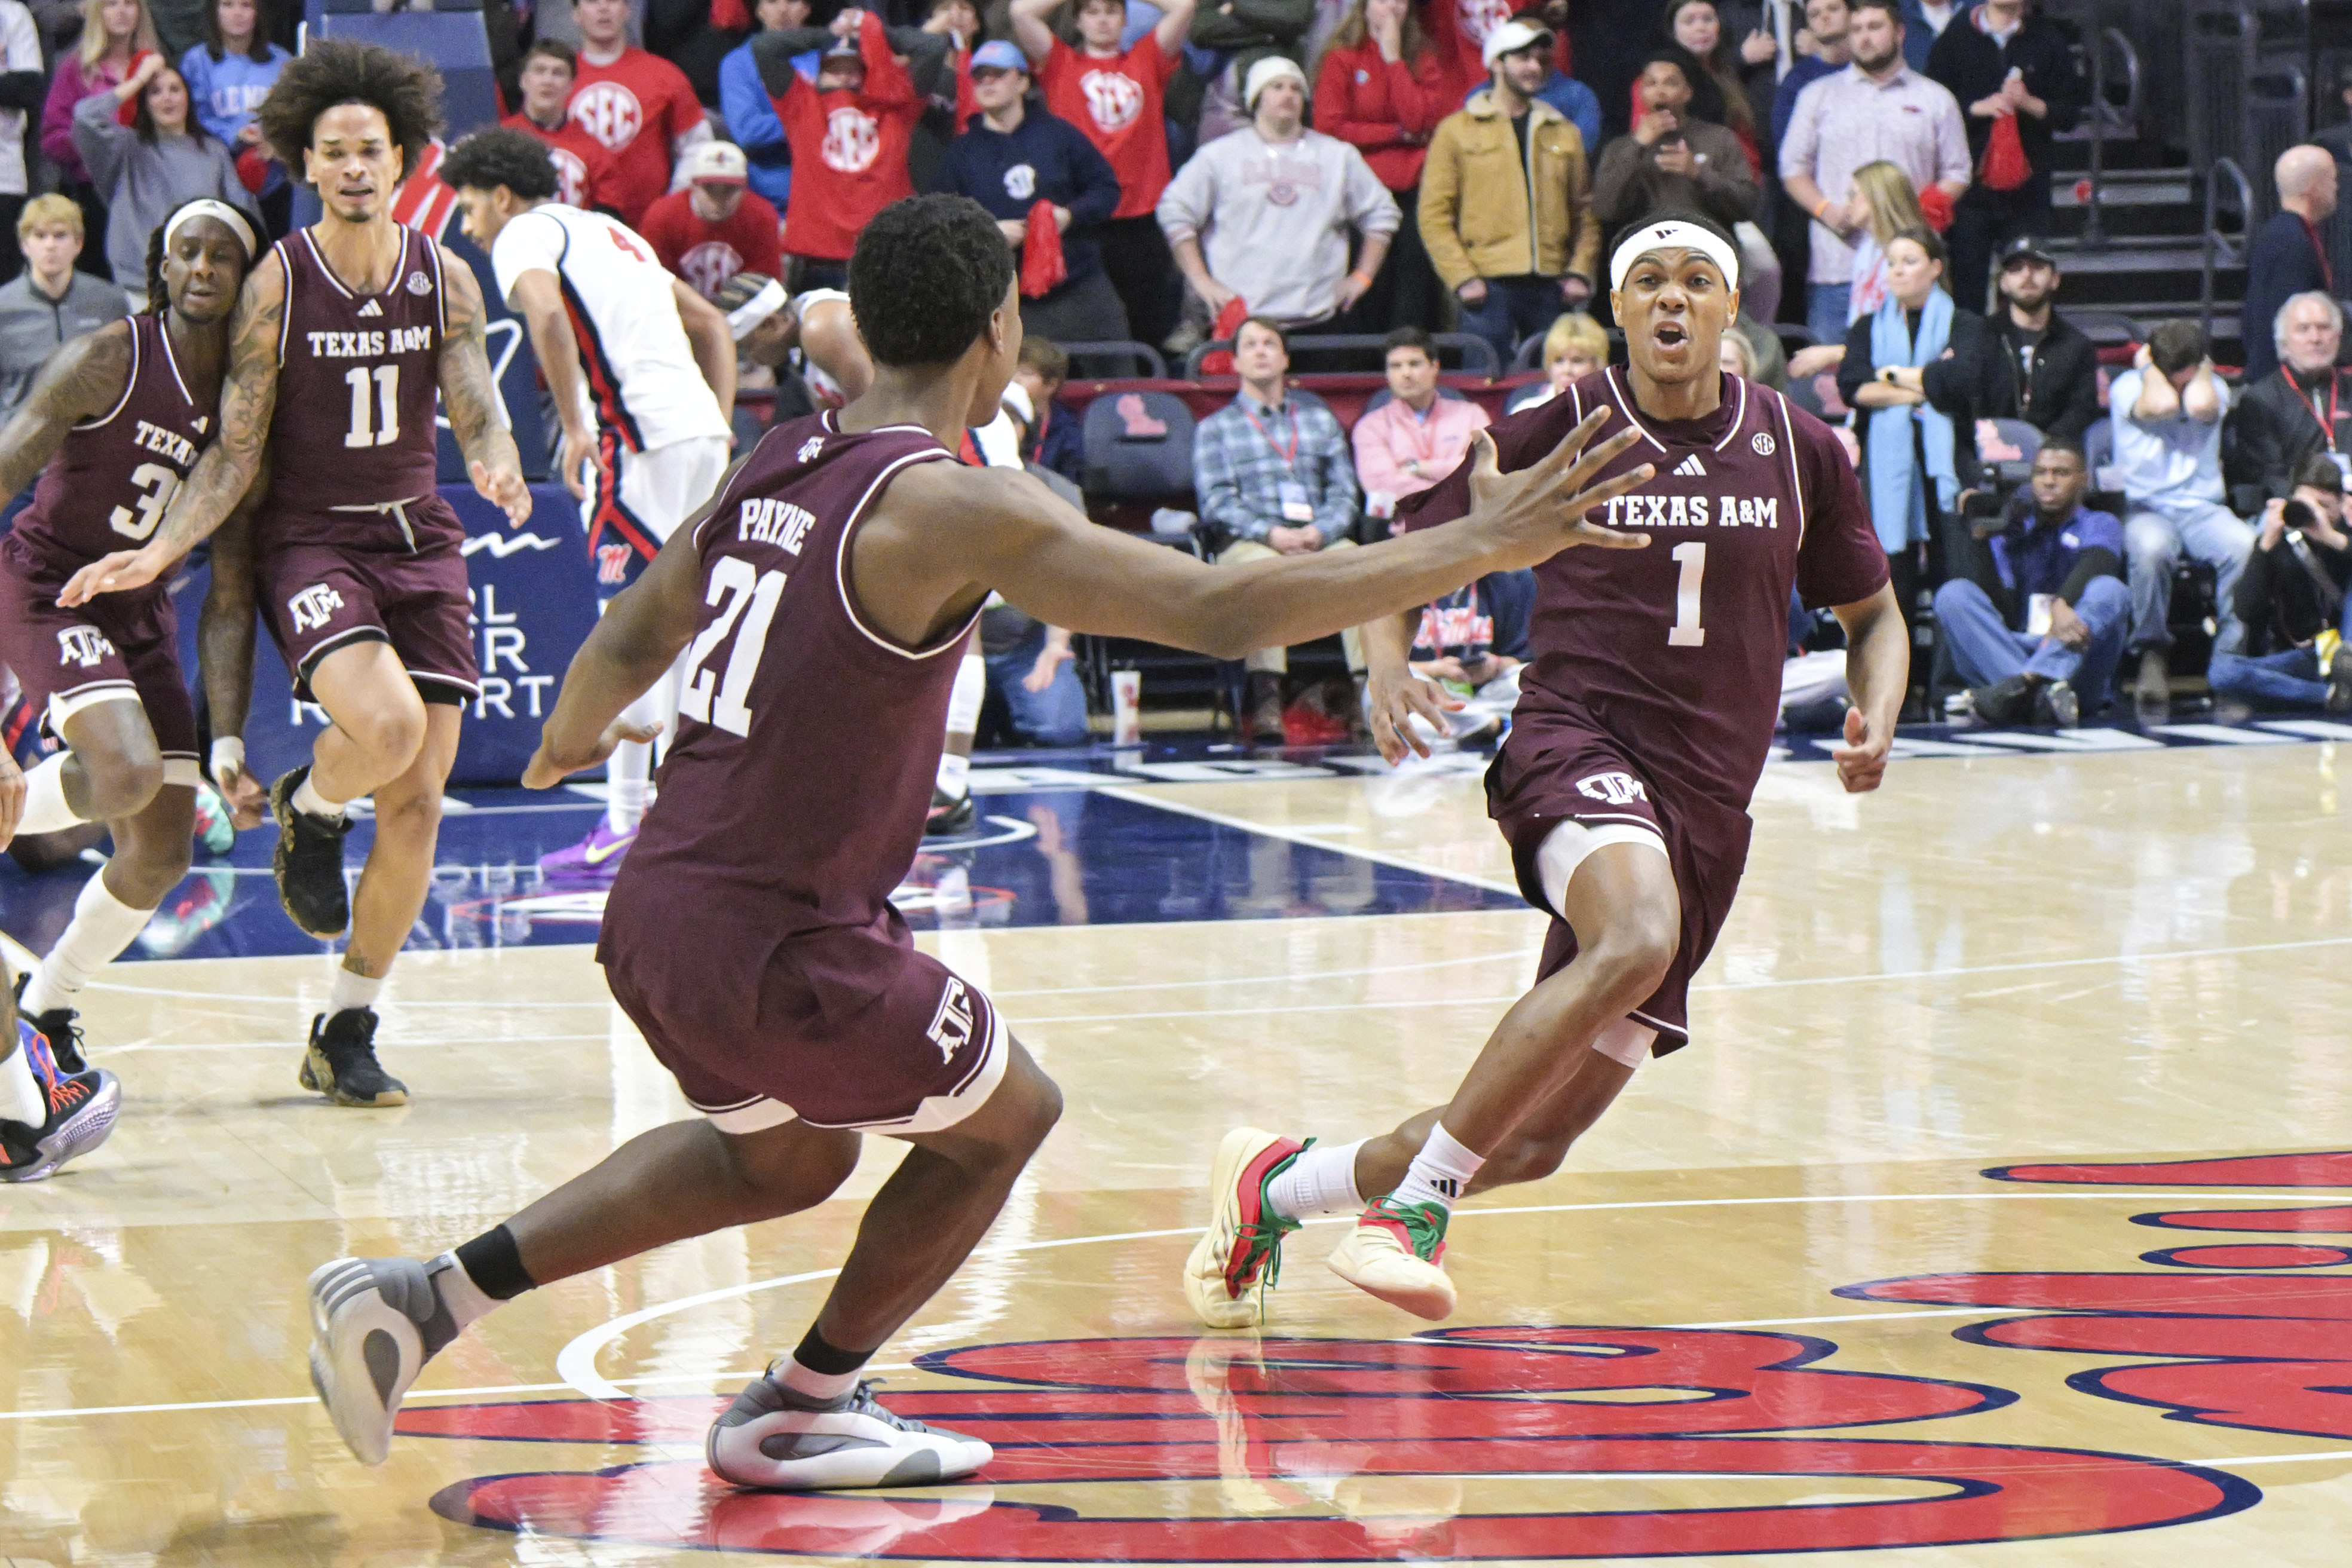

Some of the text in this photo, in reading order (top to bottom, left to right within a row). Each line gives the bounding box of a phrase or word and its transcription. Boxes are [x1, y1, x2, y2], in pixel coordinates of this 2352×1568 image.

[573, 87, 636, 149] SEC
[607, 226, 648, 262] 4
[307, 325, 432, 357] TEXAS A&M
[345, 365, 400, 448] 11
[1754, 434, 1774, 454] SEC
[738, 497, 817, 556] PAYNE
[1603, 495, 1778, 529] TEXAS A&M
[1668, 541, 1707, 647] 1
[678, 555, 787, 739] 21
